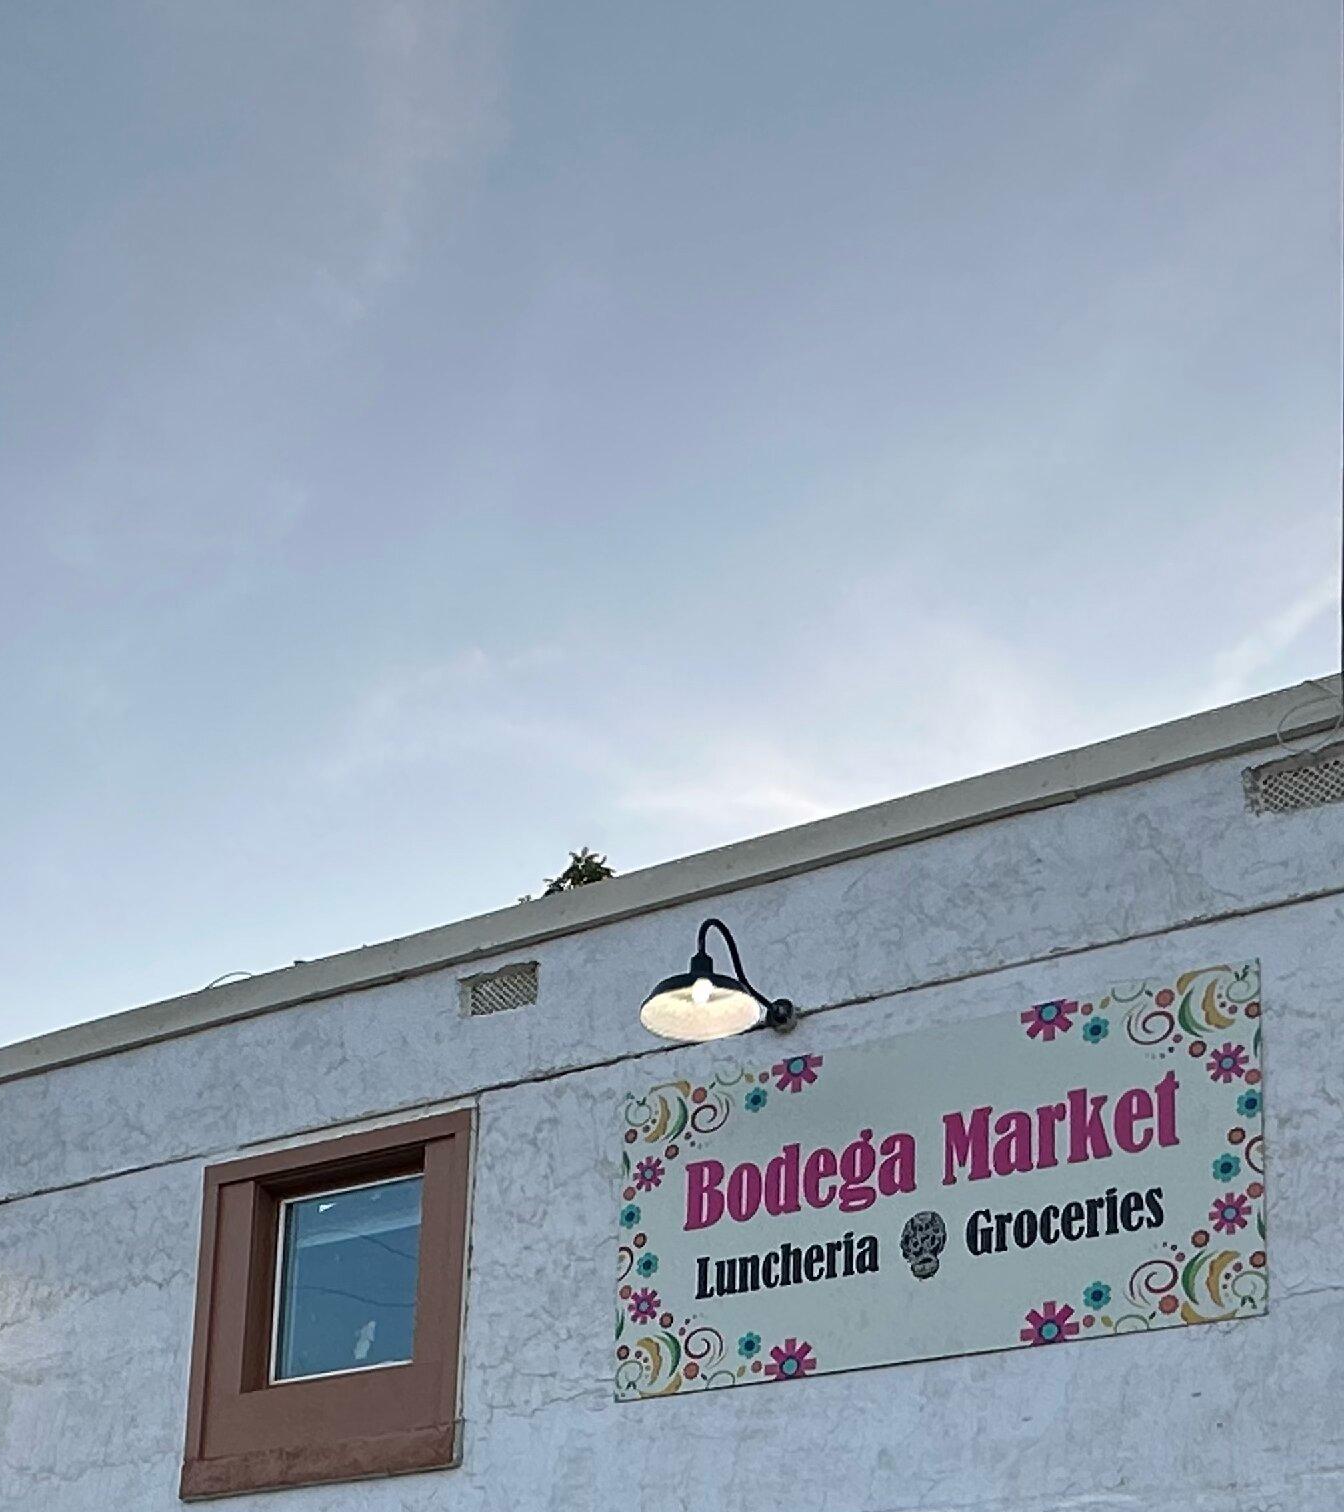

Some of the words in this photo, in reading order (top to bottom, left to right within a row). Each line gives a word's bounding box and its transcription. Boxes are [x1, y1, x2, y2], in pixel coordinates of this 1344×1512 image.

[683, 1128, 917, 1232] Bodega
[941, 1070, 1181, 1187] Market
[694, 1231, 880, 1300] Luncheria
[964, 1186, 1166, 1257] Groceries
